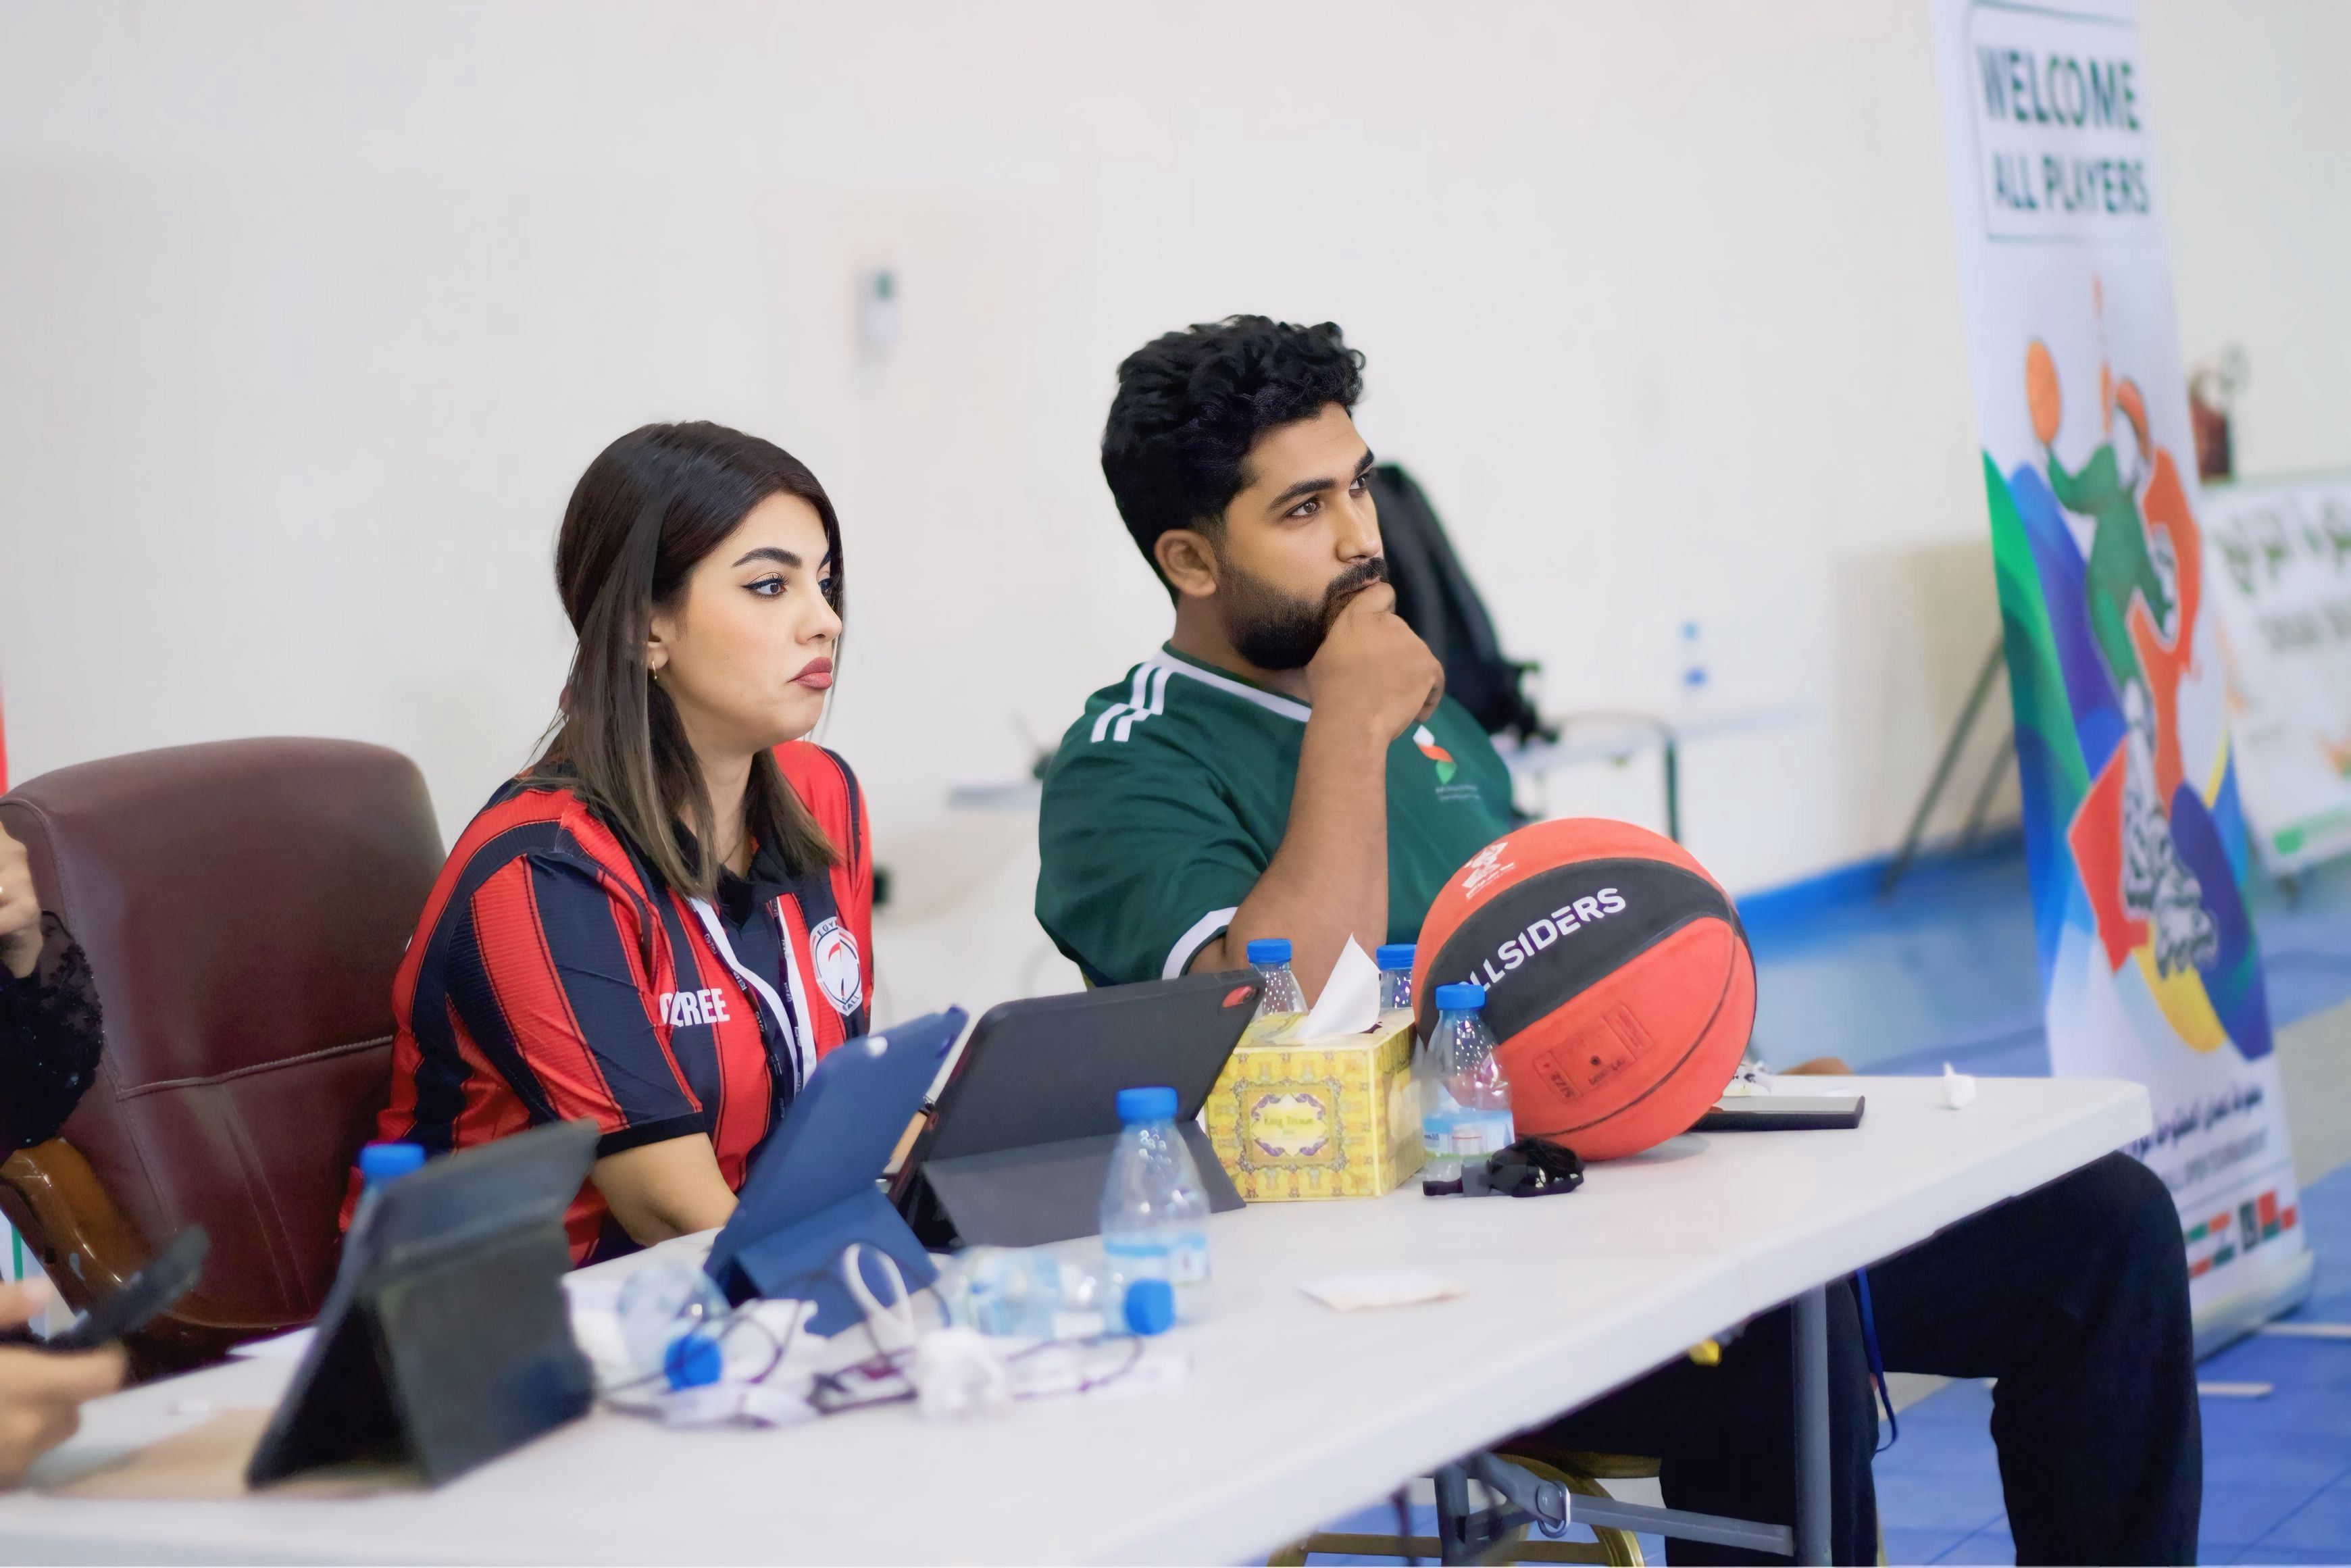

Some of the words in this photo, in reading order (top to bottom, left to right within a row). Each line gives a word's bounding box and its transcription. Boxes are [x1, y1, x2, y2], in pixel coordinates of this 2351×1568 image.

[1974, 45, 2140, 131] WELCOME
[1993, 153, 2039, 210] ALL
[2042, 155, 2150, 214] PLAYERS
[1459, 888, 1627, 992] LLSIDERS
